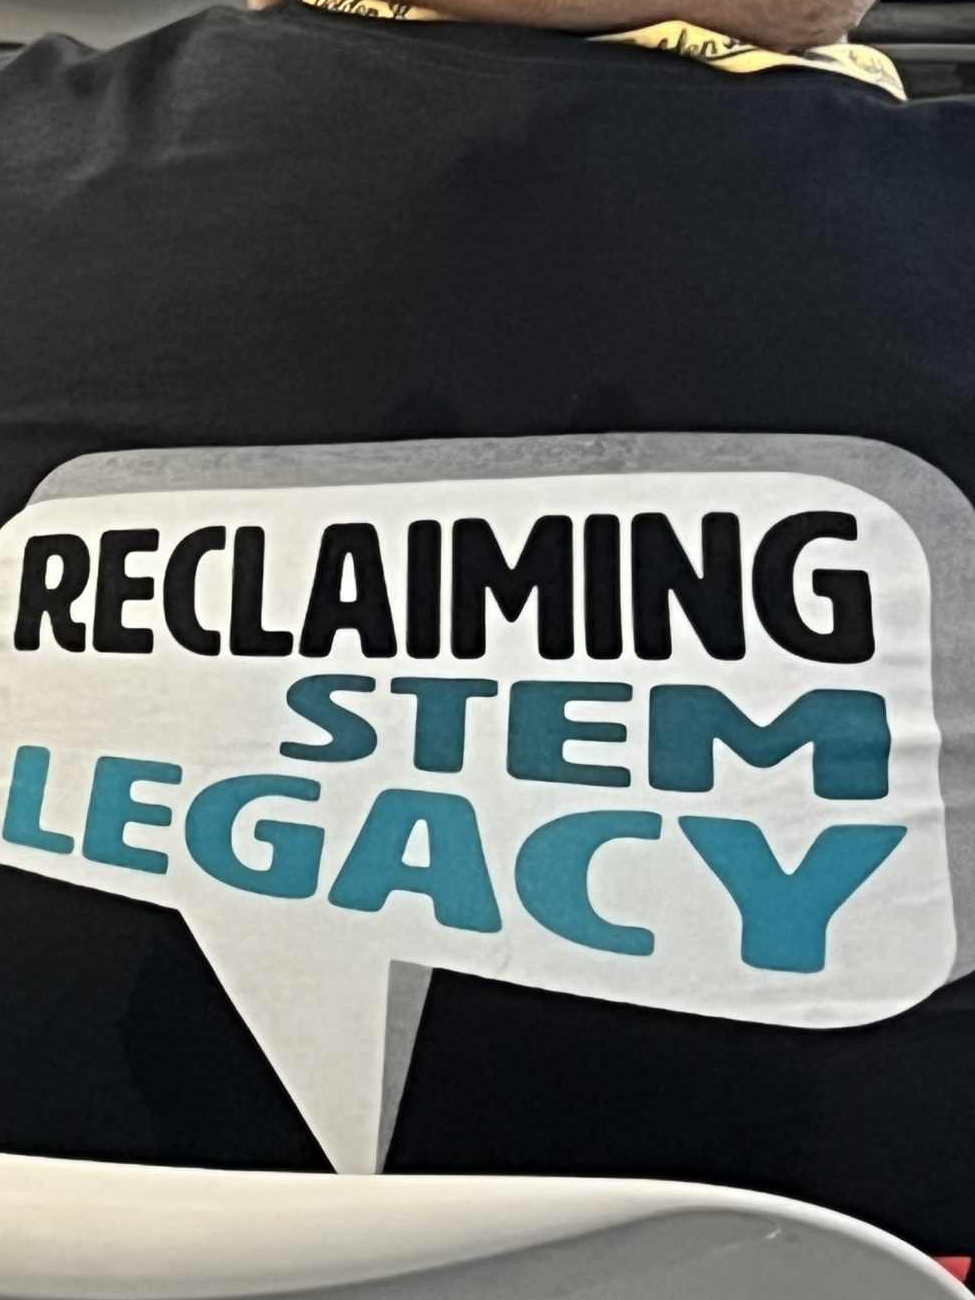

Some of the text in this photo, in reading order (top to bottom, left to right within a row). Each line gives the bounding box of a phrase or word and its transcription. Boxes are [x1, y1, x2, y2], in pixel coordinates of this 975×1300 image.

[13, 510, 876, 664] RECLAIMING
[279, 673, 892, 801] STEM
[1, 743, 909, 975] LEGACY
